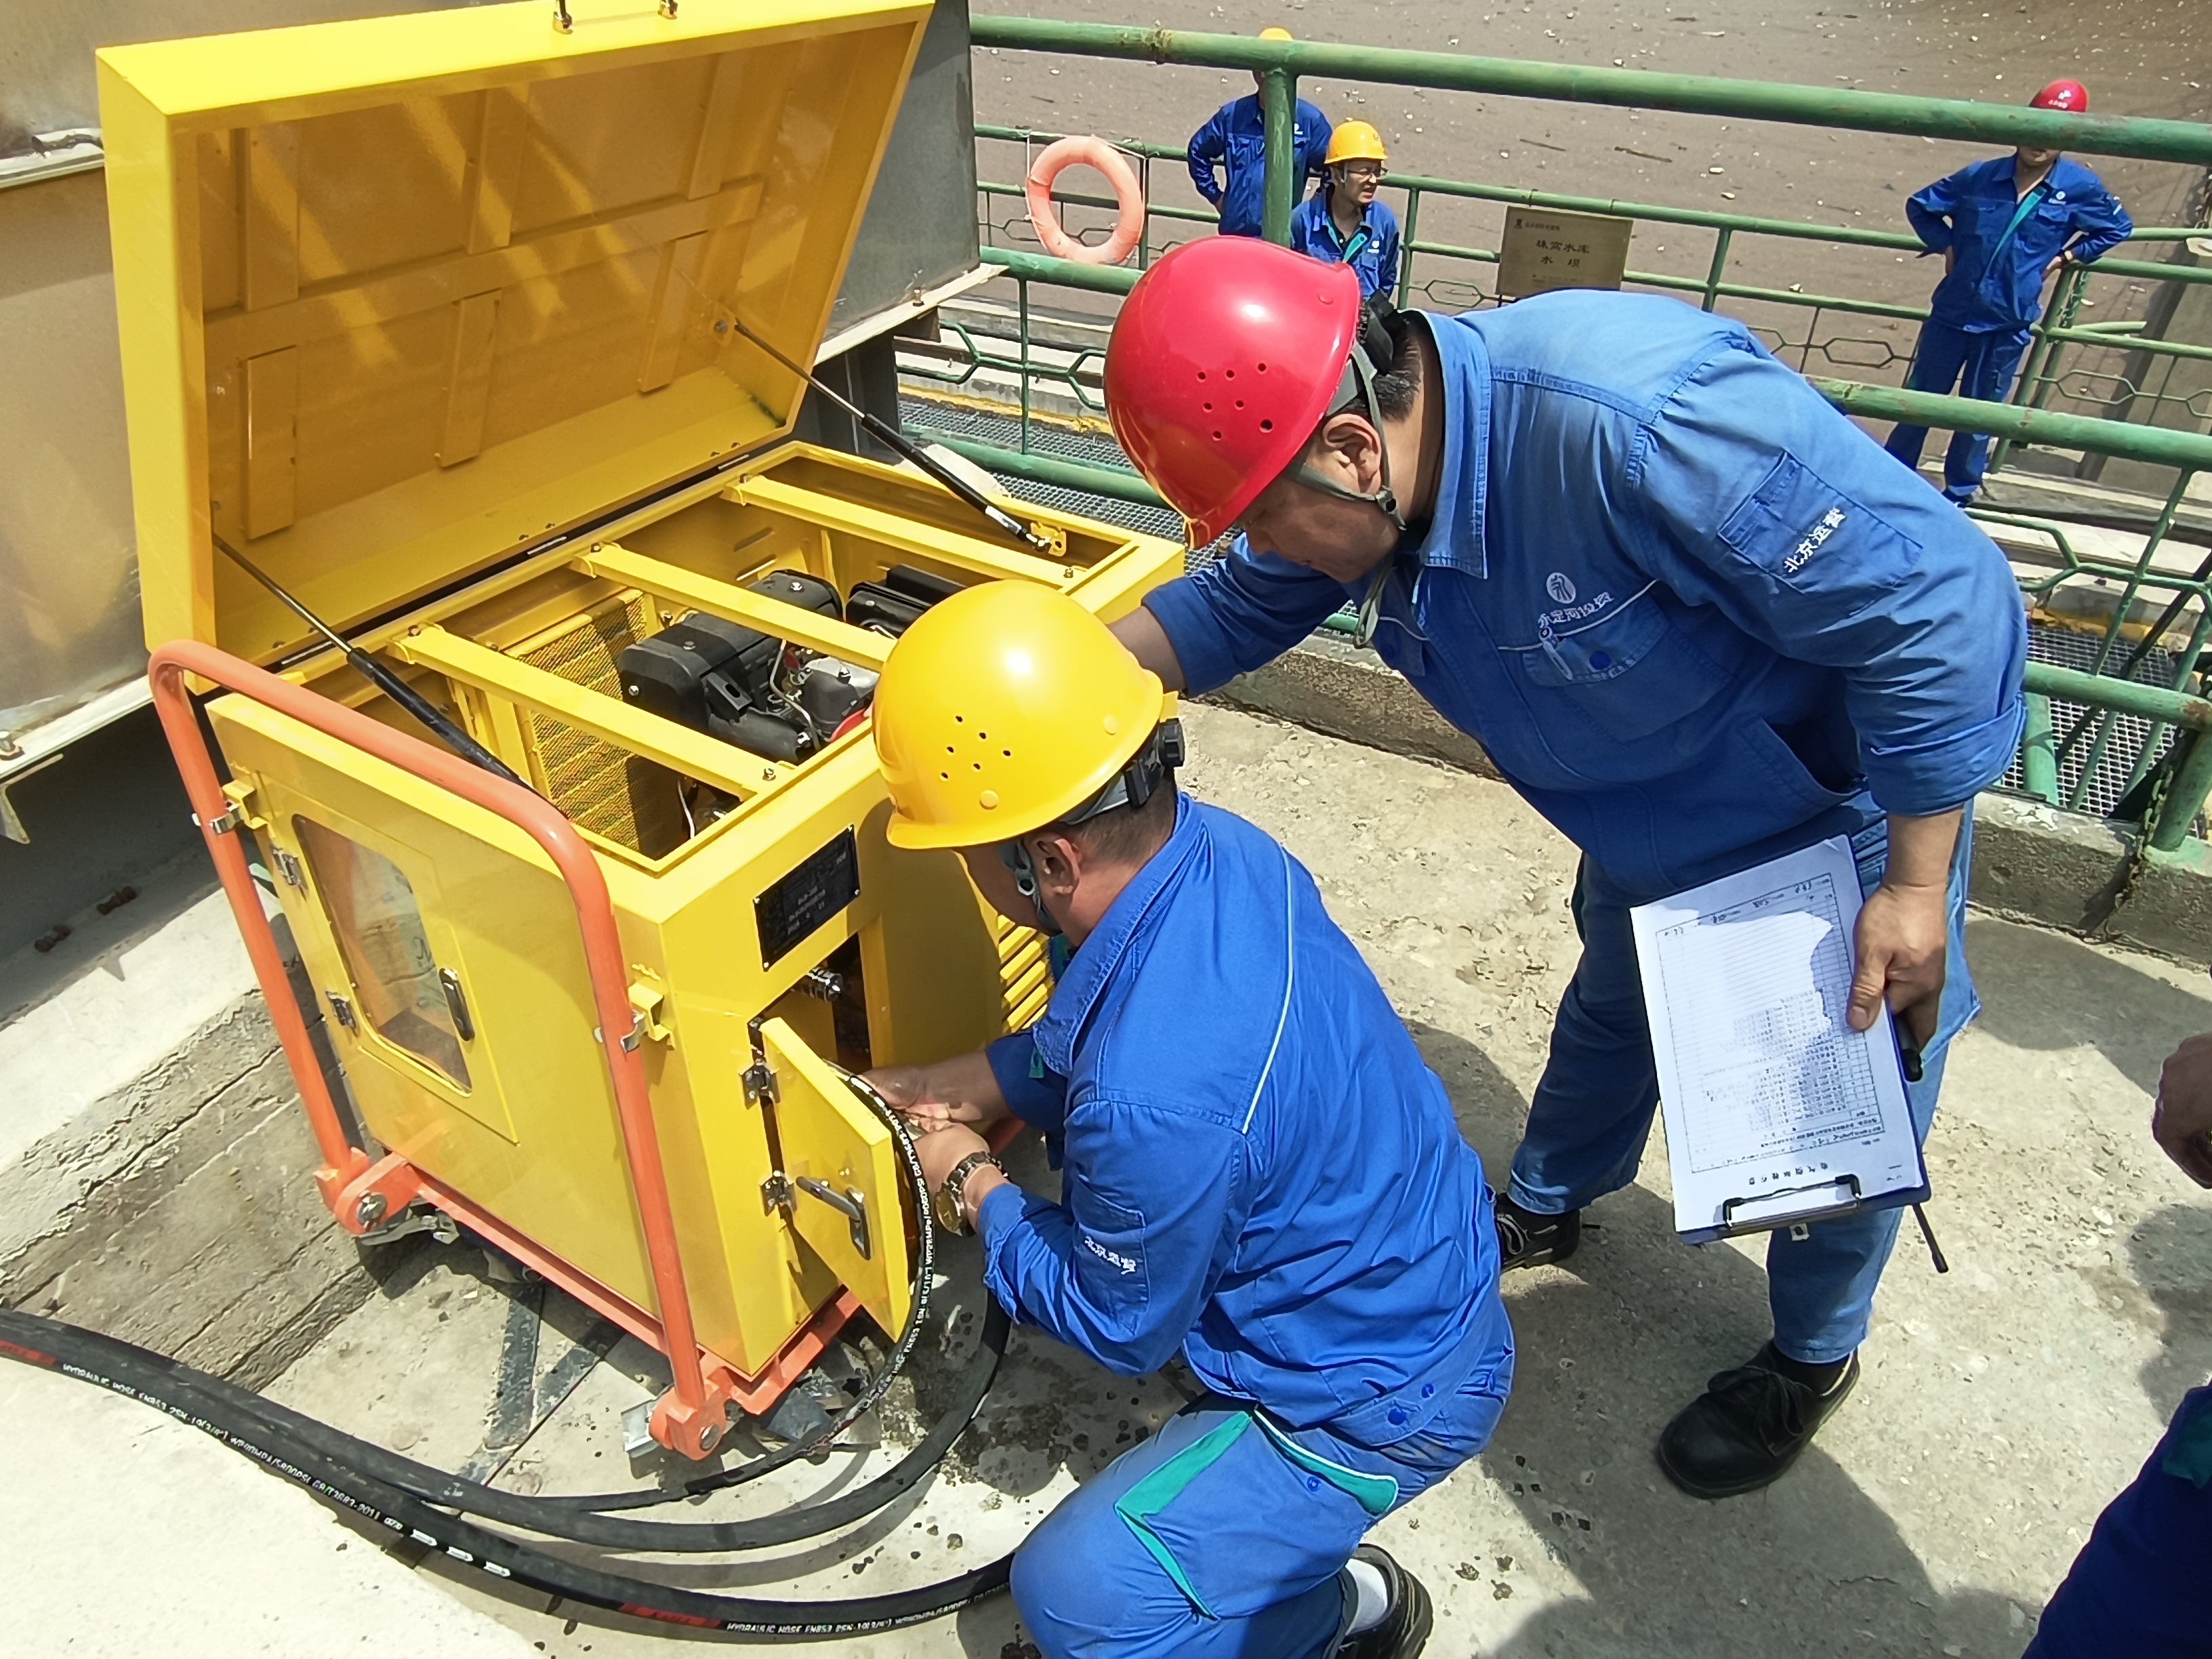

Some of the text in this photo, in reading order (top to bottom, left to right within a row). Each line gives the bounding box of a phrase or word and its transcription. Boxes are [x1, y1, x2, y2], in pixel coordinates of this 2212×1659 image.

[112, 1382, 136, 1397] HOSE
[726, 1622, 776, 1635] HYDRAULIC
[778, 1624, 802, 1635] HOSE
